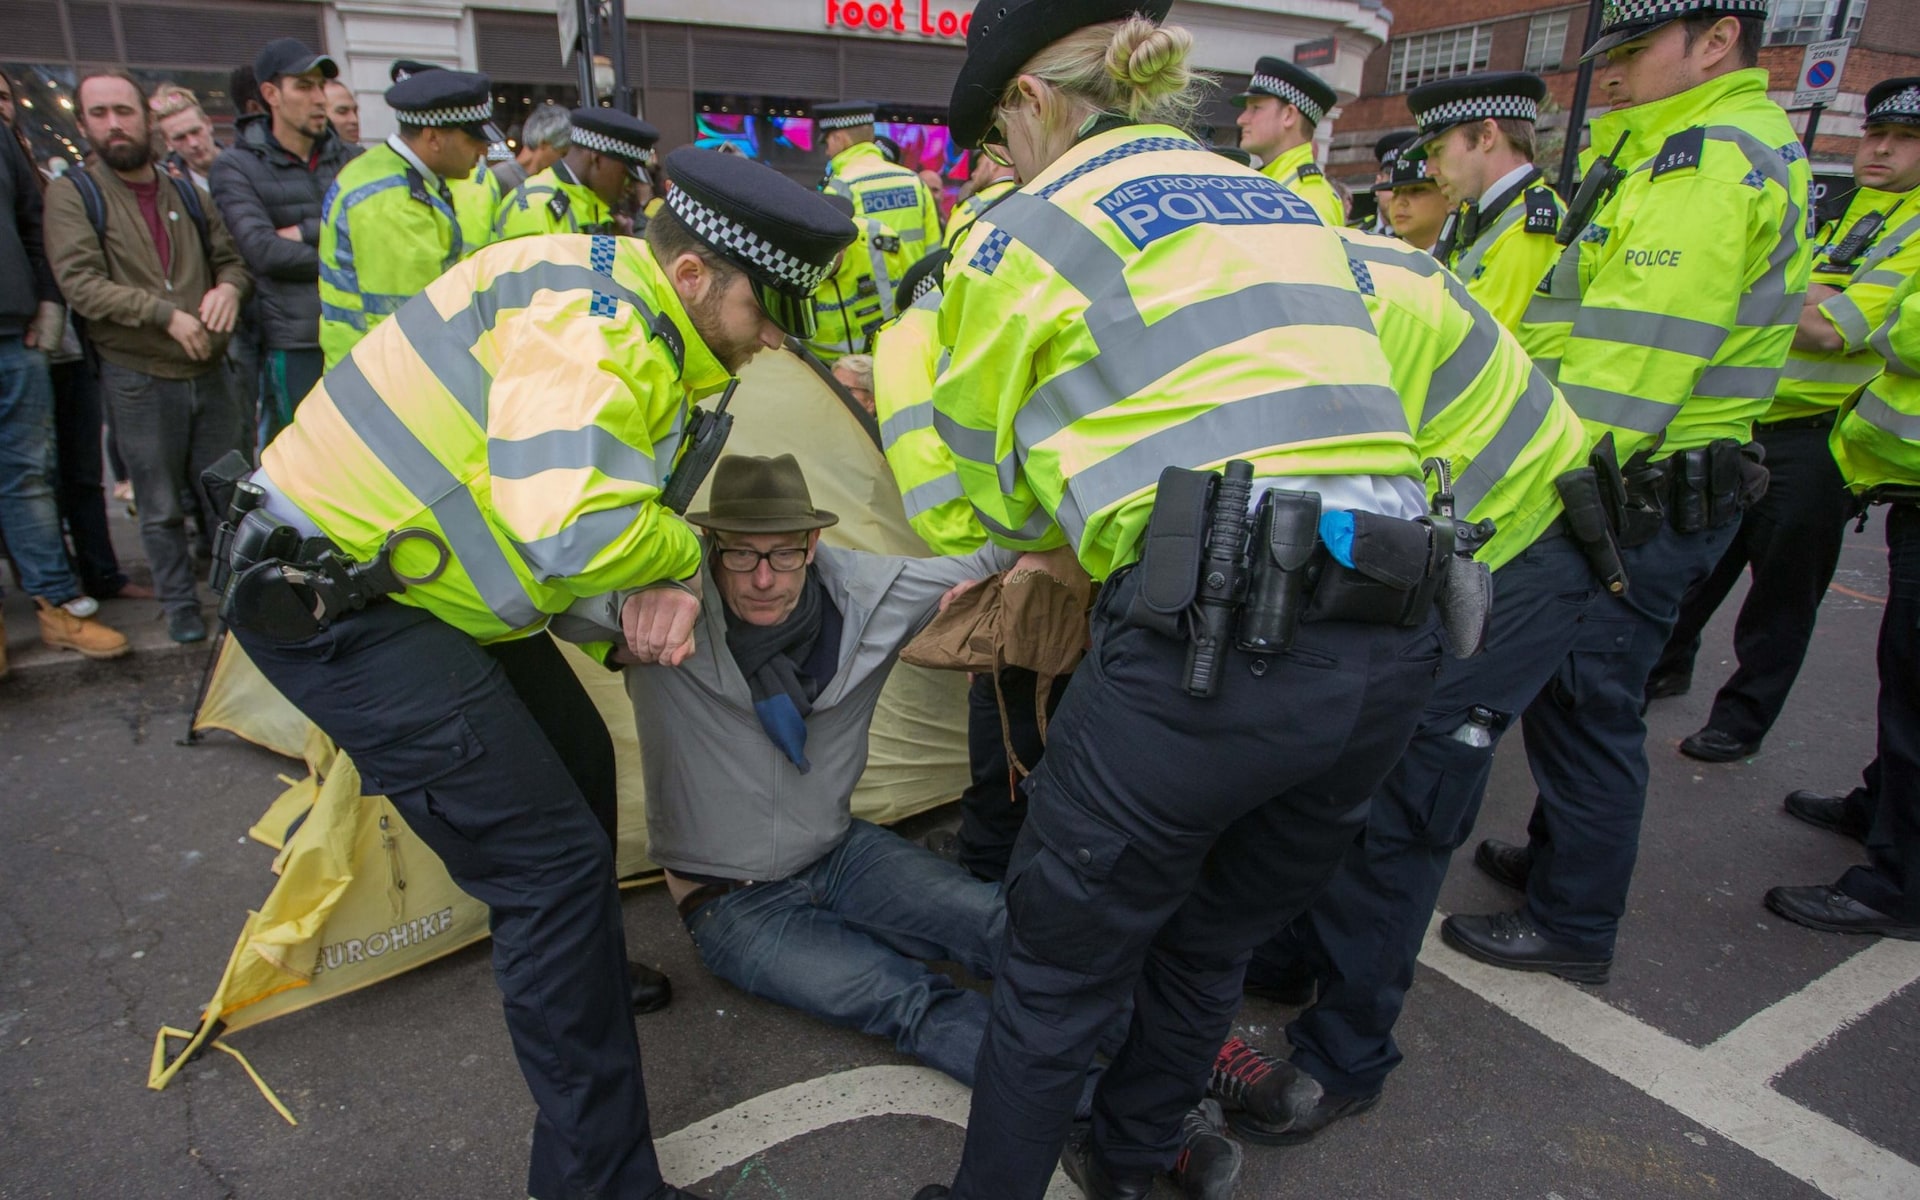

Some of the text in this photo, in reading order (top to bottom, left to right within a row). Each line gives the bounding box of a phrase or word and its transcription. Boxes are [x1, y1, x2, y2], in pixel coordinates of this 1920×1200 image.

[1811, 49, 1840, 60] ZONE
[864, 193, 917, 212] POLICE
[1102, 176, 1288, 212] METROPOLITAN
[1116, 191, 1317, 241] POLICE
[1535, 207, 1551, 216] CE
[1625, 249, 1682, 266] POLICE
